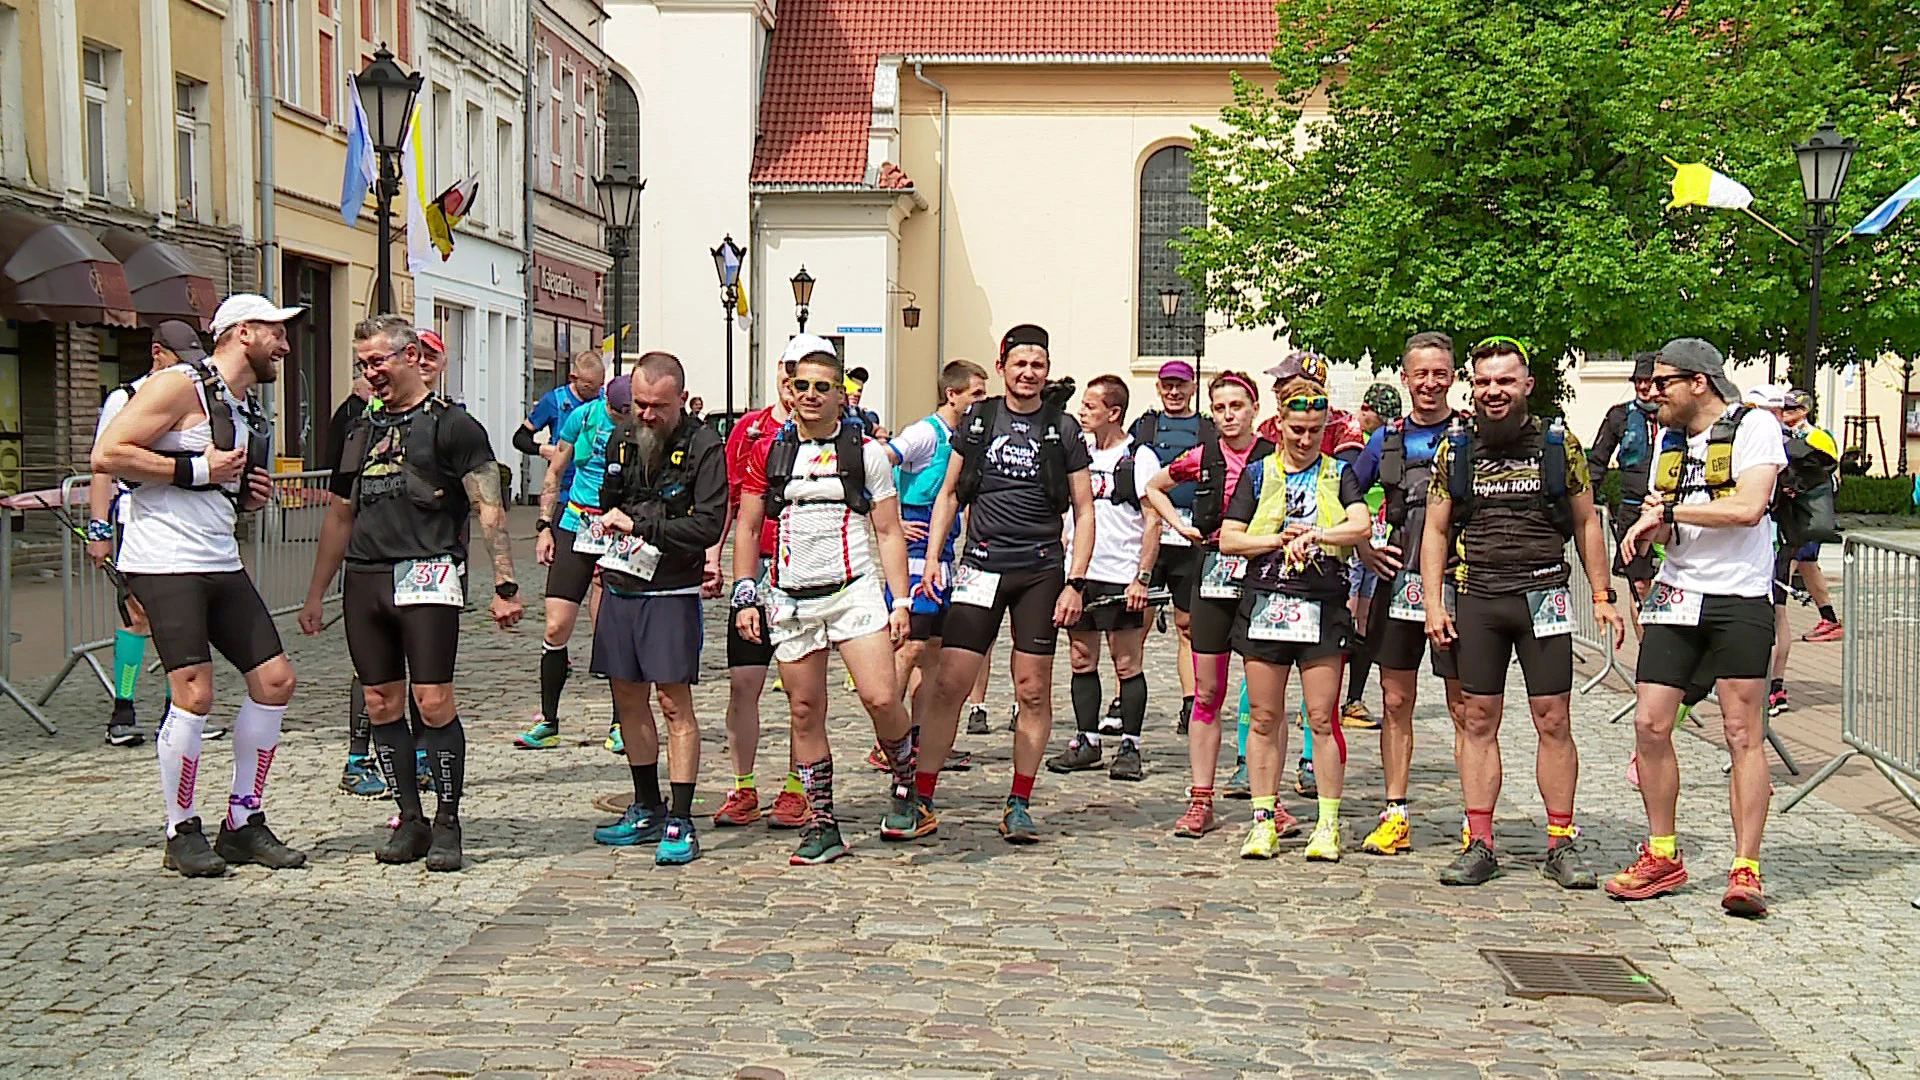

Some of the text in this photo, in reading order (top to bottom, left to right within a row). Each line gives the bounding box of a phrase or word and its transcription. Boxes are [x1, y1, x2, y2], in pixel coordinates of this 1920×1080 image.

[1002, 444, 1035, 459] POLISH
[1002, 453, 1034, 468] WINGS
[1511, 479, 1541, 493] 1000
[414, 563, 450, 585] 37
[1224, 561, 1239, 579] 7
[1554, 593, 1566, 614] 9
[1656, 585, 1685, 605] 38
[1269, 602, 1302, 623] 33
